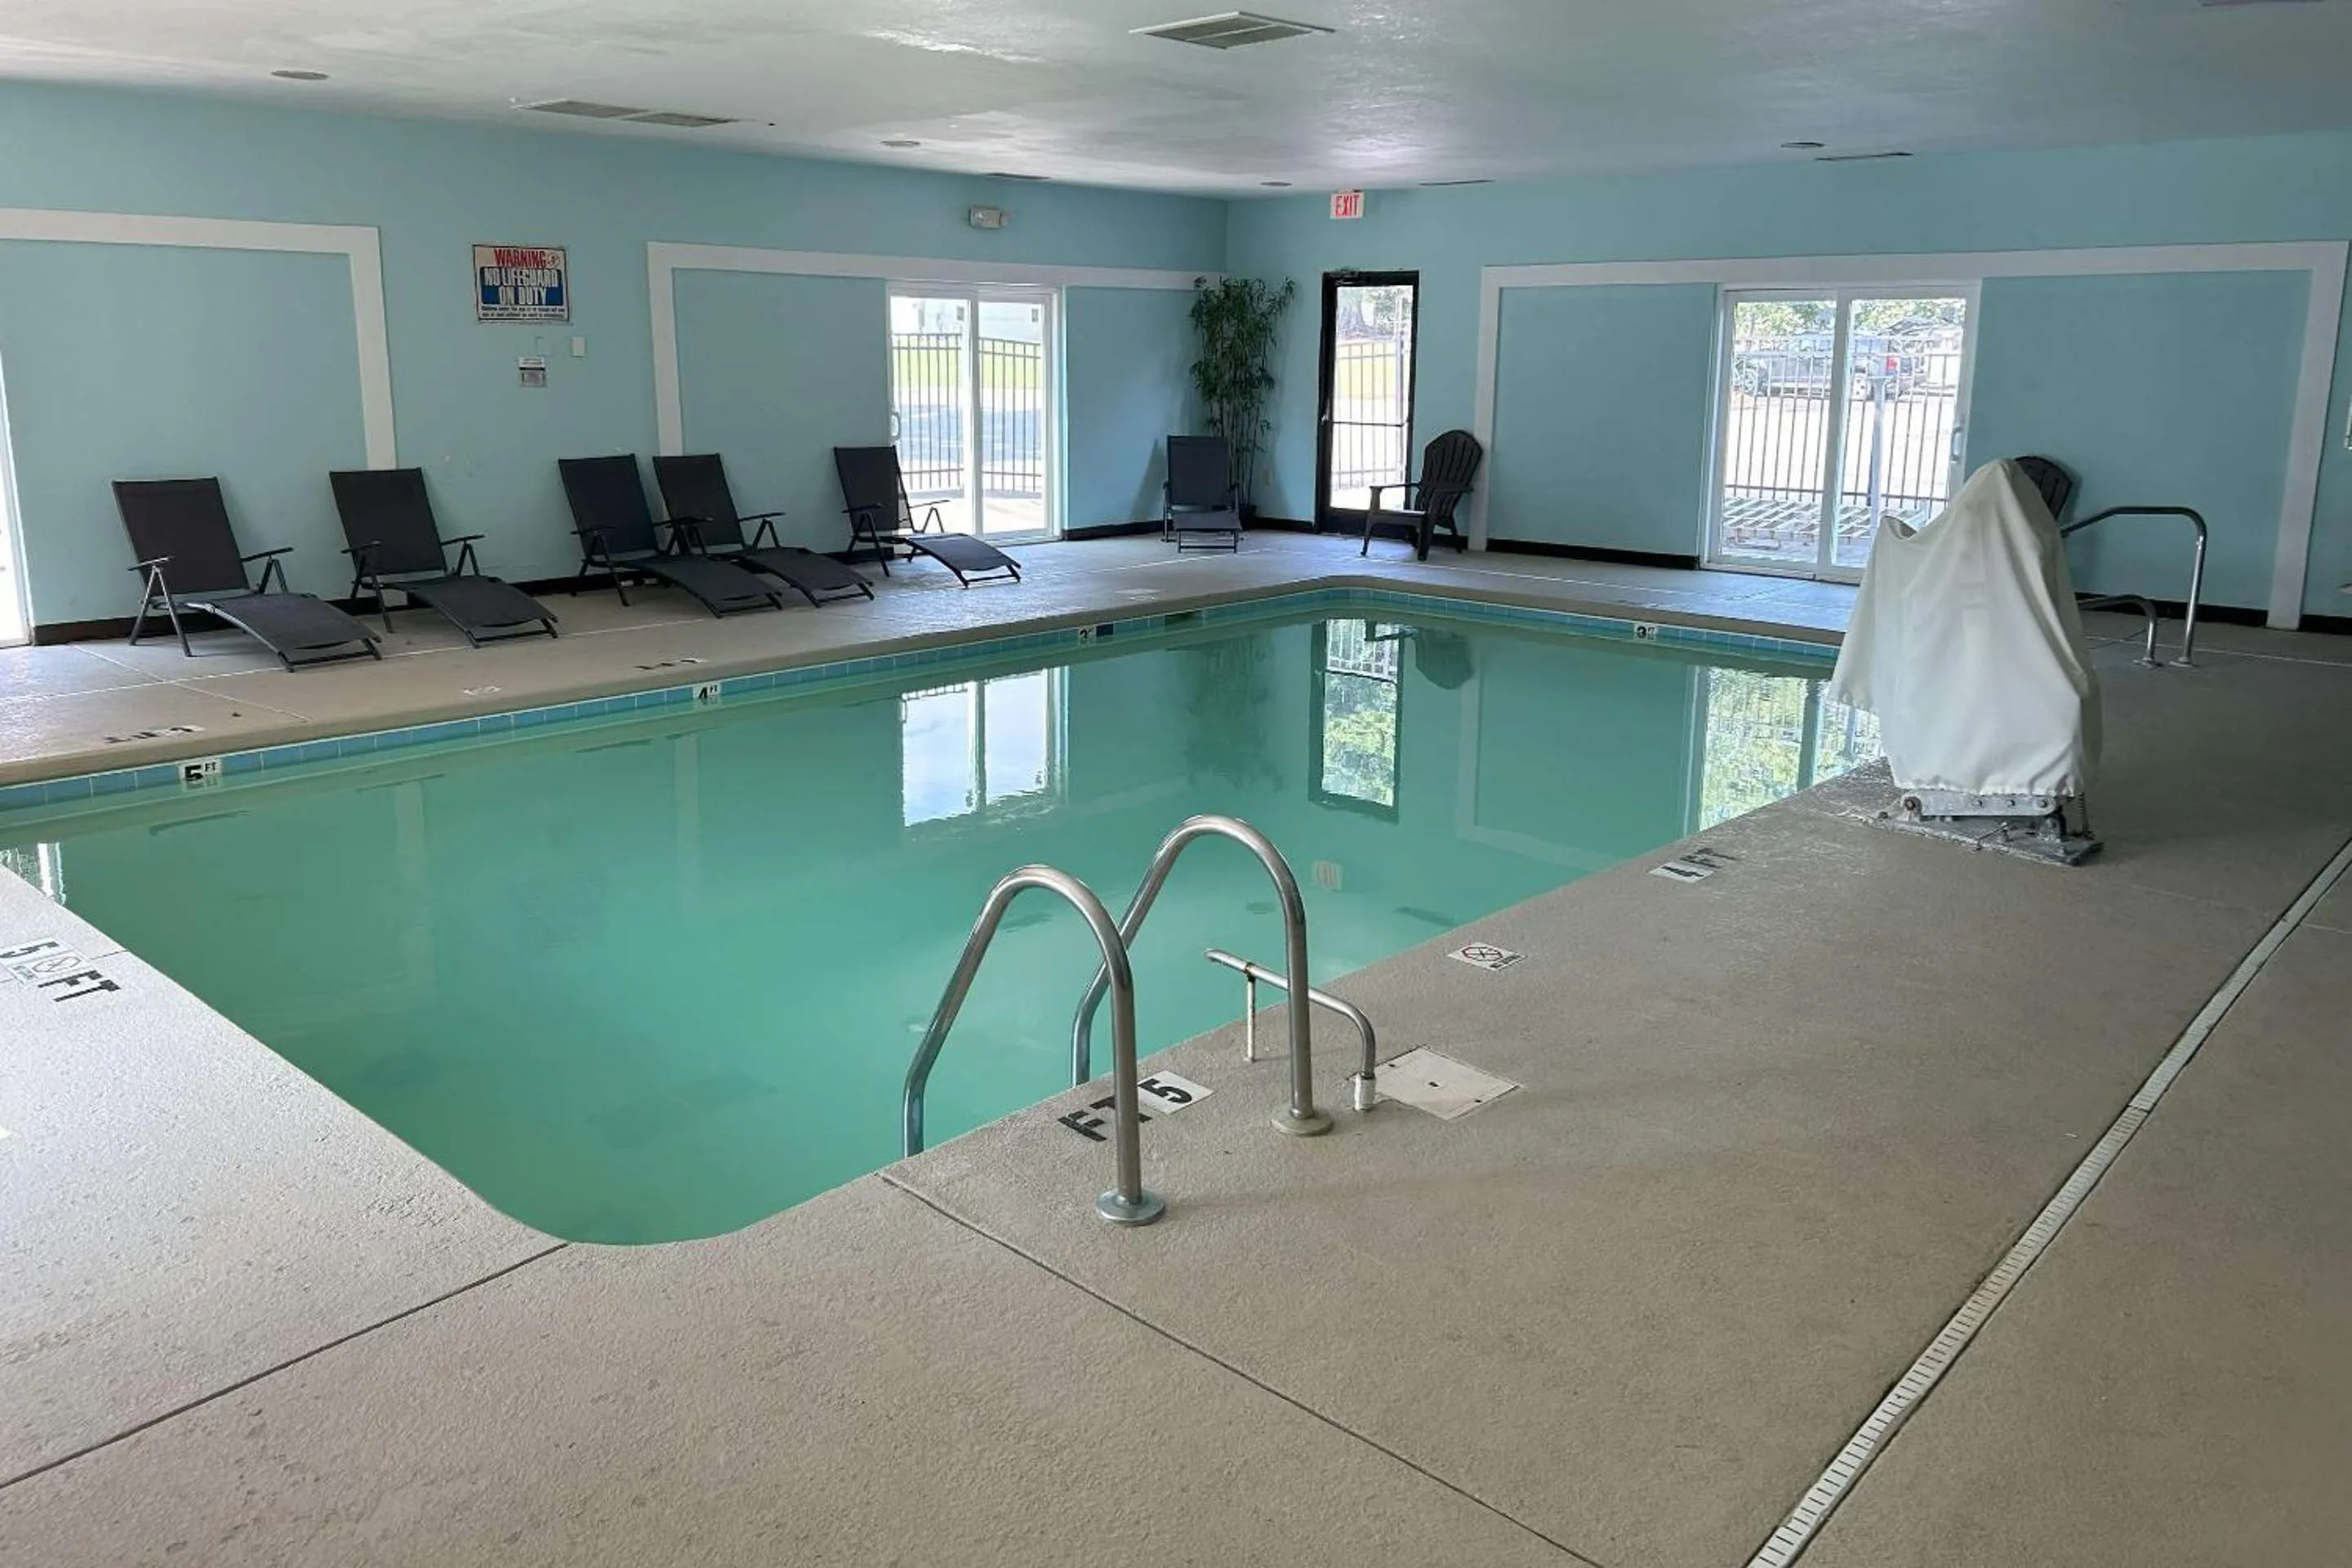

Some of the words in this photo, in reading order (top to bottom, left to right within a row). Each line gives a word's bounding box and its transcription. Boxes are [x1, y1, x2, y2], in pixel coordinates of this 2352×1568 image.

[1335, 194, 1359, 216] EXIT
[494, 248, 546, 269] WARNING
[484, 268, 500, 287] NO
[501, 269, 559, 288] LIFEGUARD
[499, 287, 514, 305] ON
[519, 287, 546, 306] DUTY
[185, 764, 203, 781] 5
[205, 761, 216, 772] FT
[1680, 848, 1738, 870] FT
[38, 969, 122, 1003] FT
[1138, 1078, 1192, 1104] 5
